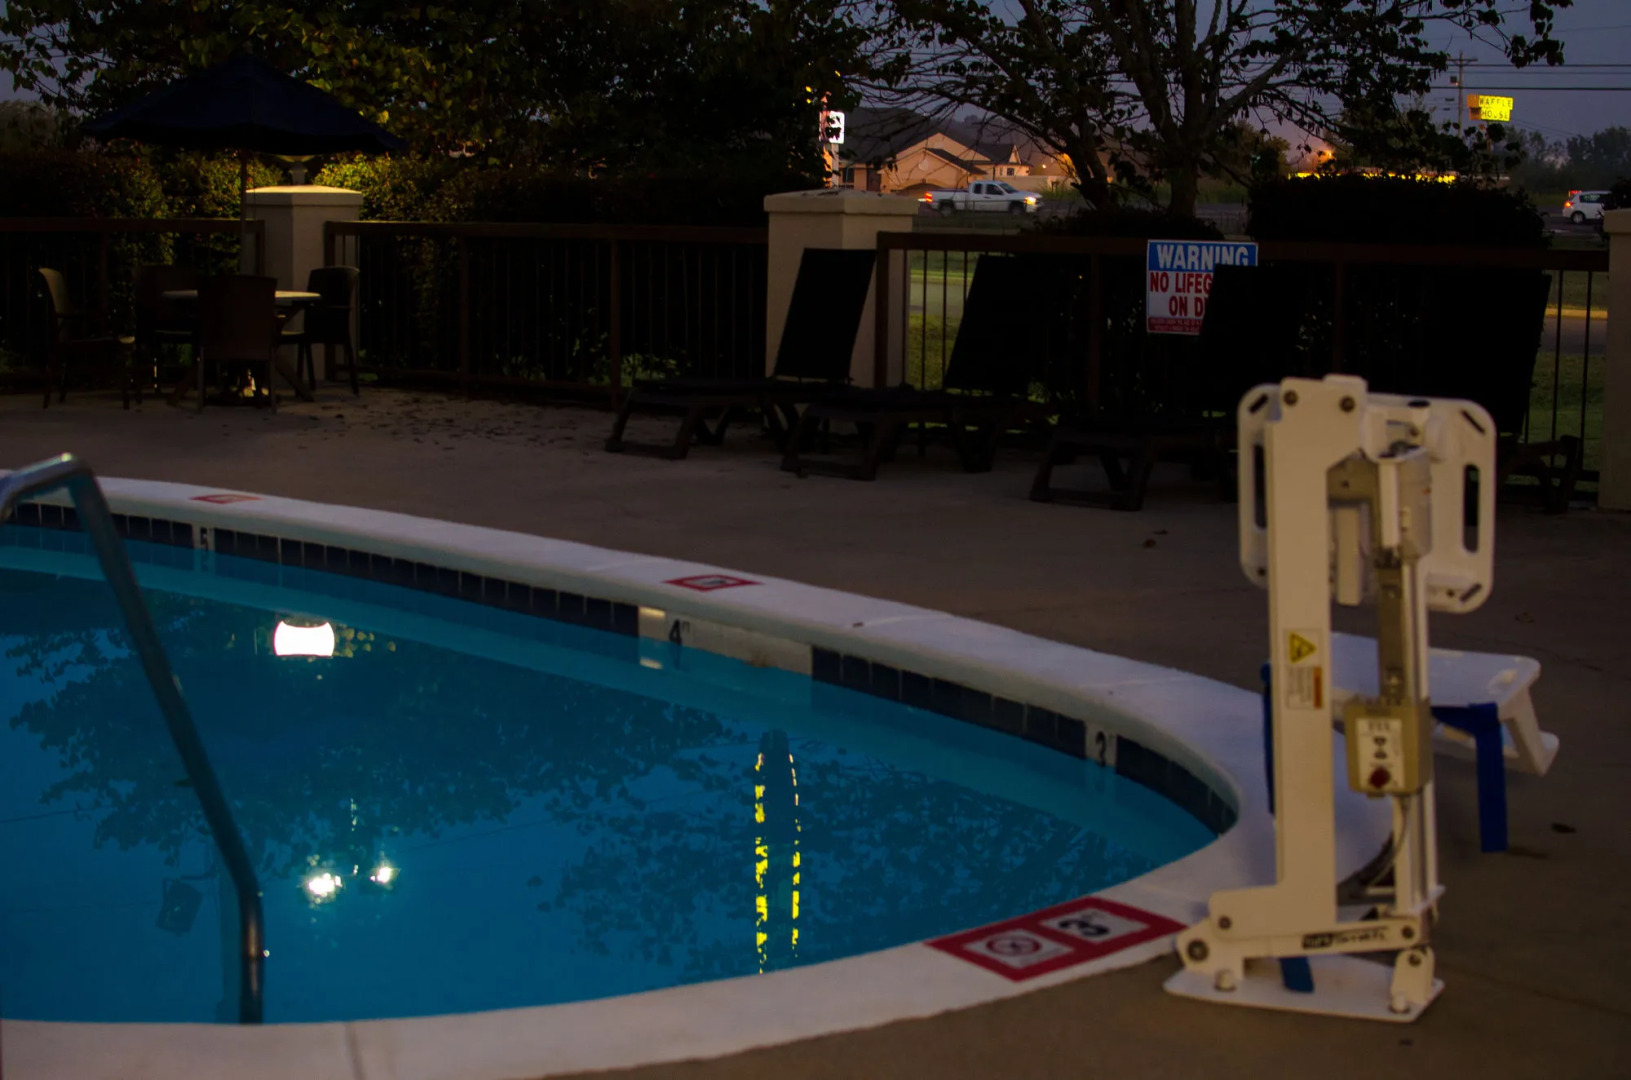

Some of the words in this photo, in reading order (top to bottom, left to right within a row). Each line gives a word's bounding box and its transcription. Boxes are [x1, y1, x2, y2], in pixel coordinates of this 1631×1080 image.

[1480, 98, 1512, 107] WAFFLE
[1157, 244, 1249, 270] WARNING
[1150, 272, 1169, 292] NO
[1169, 296, 1188, 316] ON
[669, 619, 683, 646] 4
